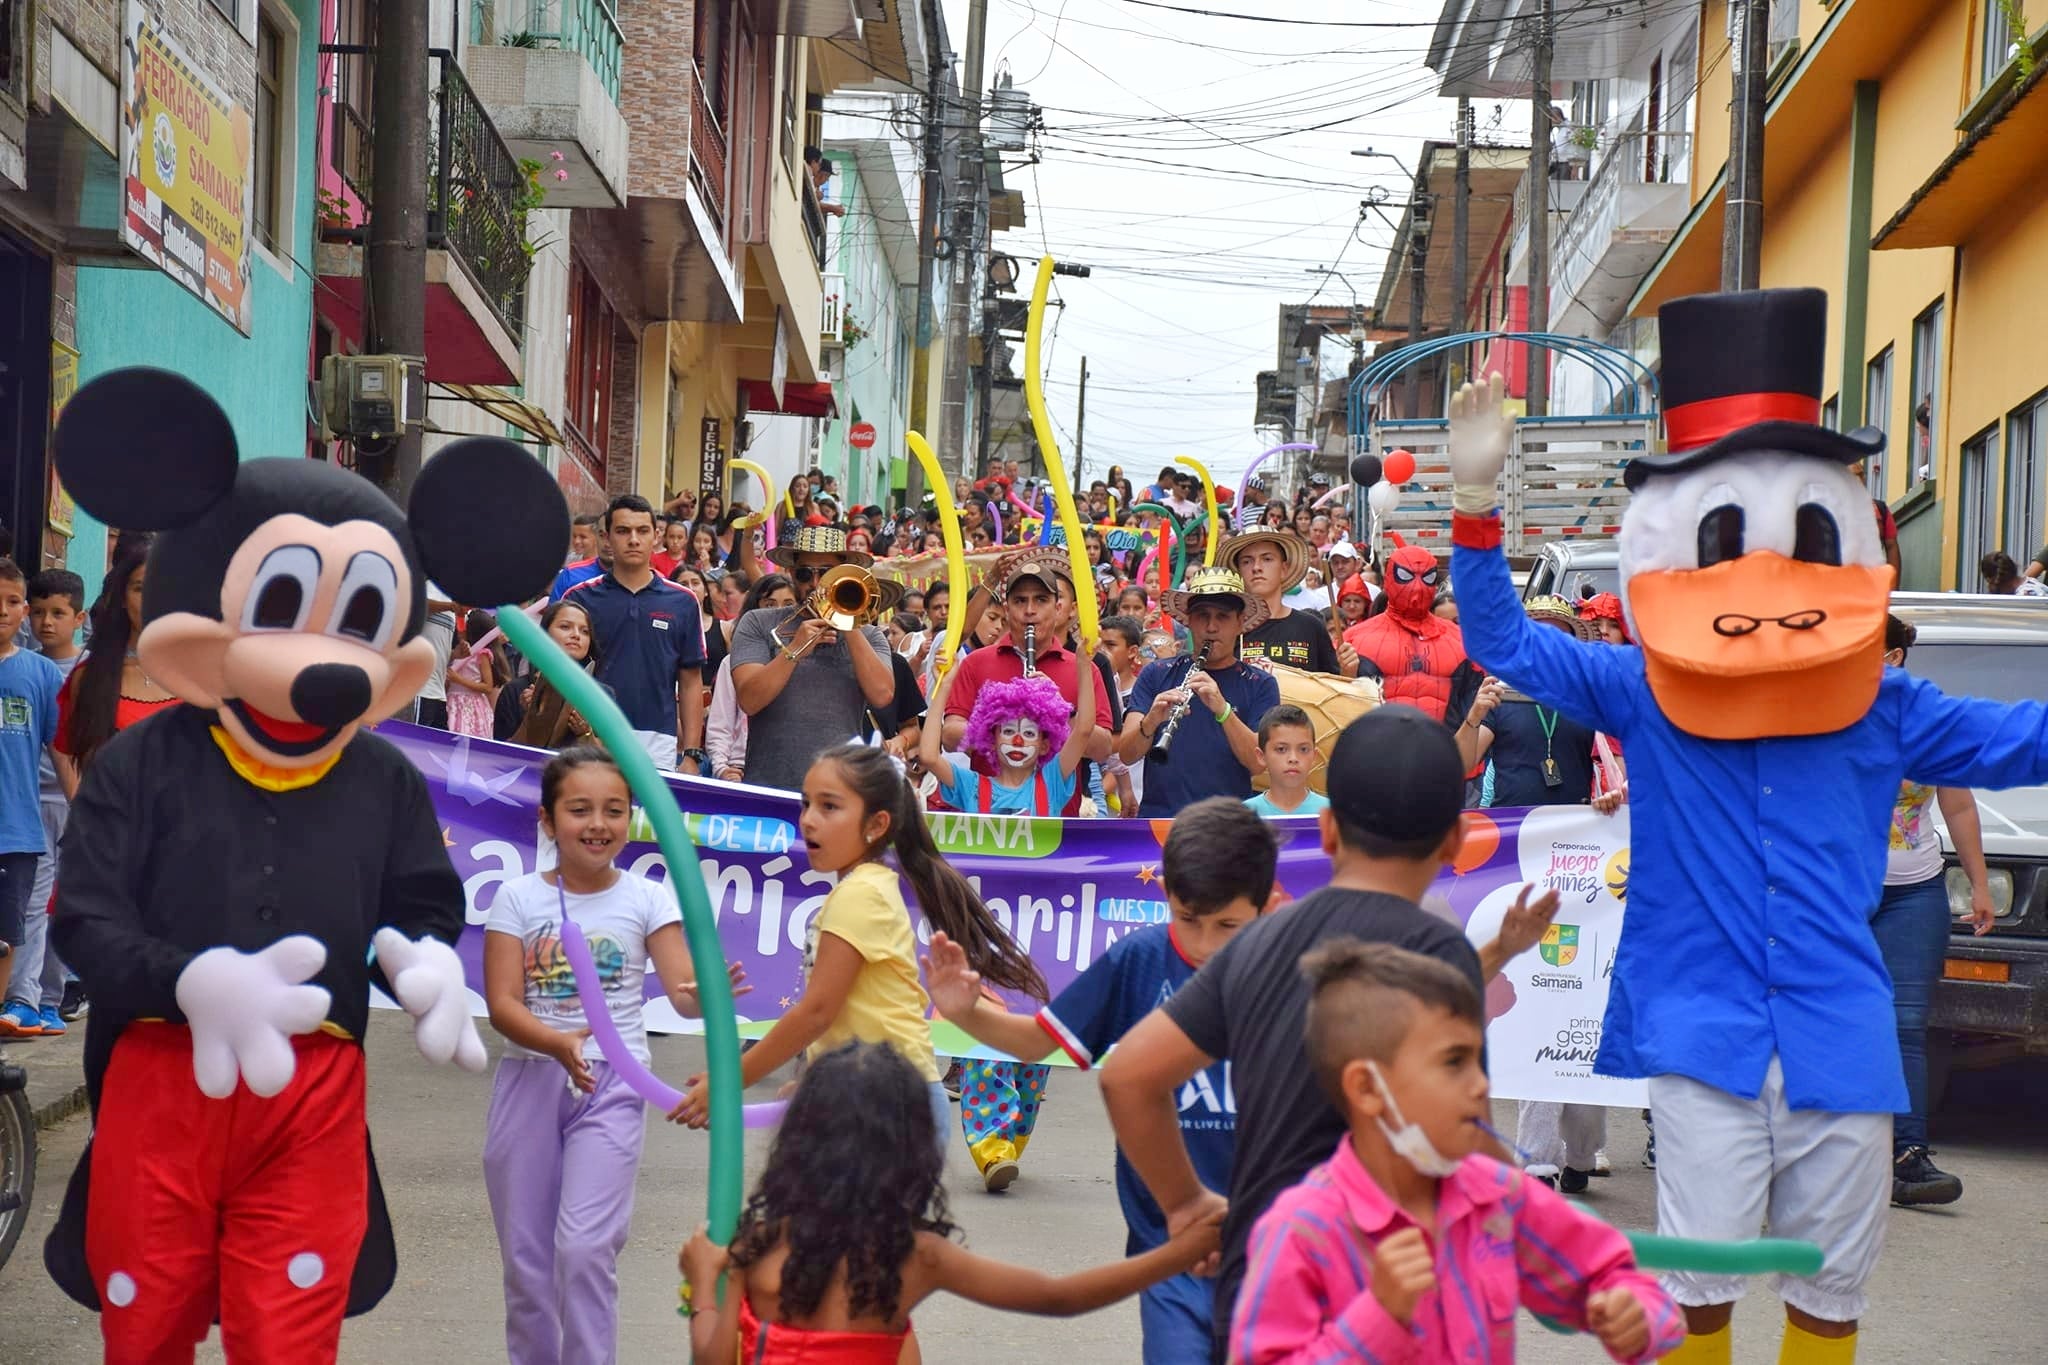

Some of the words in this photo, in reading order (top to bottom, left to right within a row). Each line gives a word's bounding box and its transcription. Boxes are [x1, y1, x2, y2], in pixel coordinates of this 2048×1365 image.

[143, 43, 210, 146] FERRAGRO
[190, 196, 204, 224] 320
[205, 209, 219, 237] 512
[219, 222, 236, 252] 9947
[208, 257, 233, 293] STIHL
[703, 421, 717, 482] TECHOS
[701, 482, 714, 491] EN
[707, 814, 743, 849] DE
[753, 819, 789, 854] LA
[1551, 841, 1601, 851] Corporación
[1545, 851, 1605, 877] juego
[1550, 873, 1603, 904] niñez
[1108, 897, 1146, 923] MES
[1531, 974, 1583, 990] Samaná
[1194, 1119, 1222, 1130] LIVE
